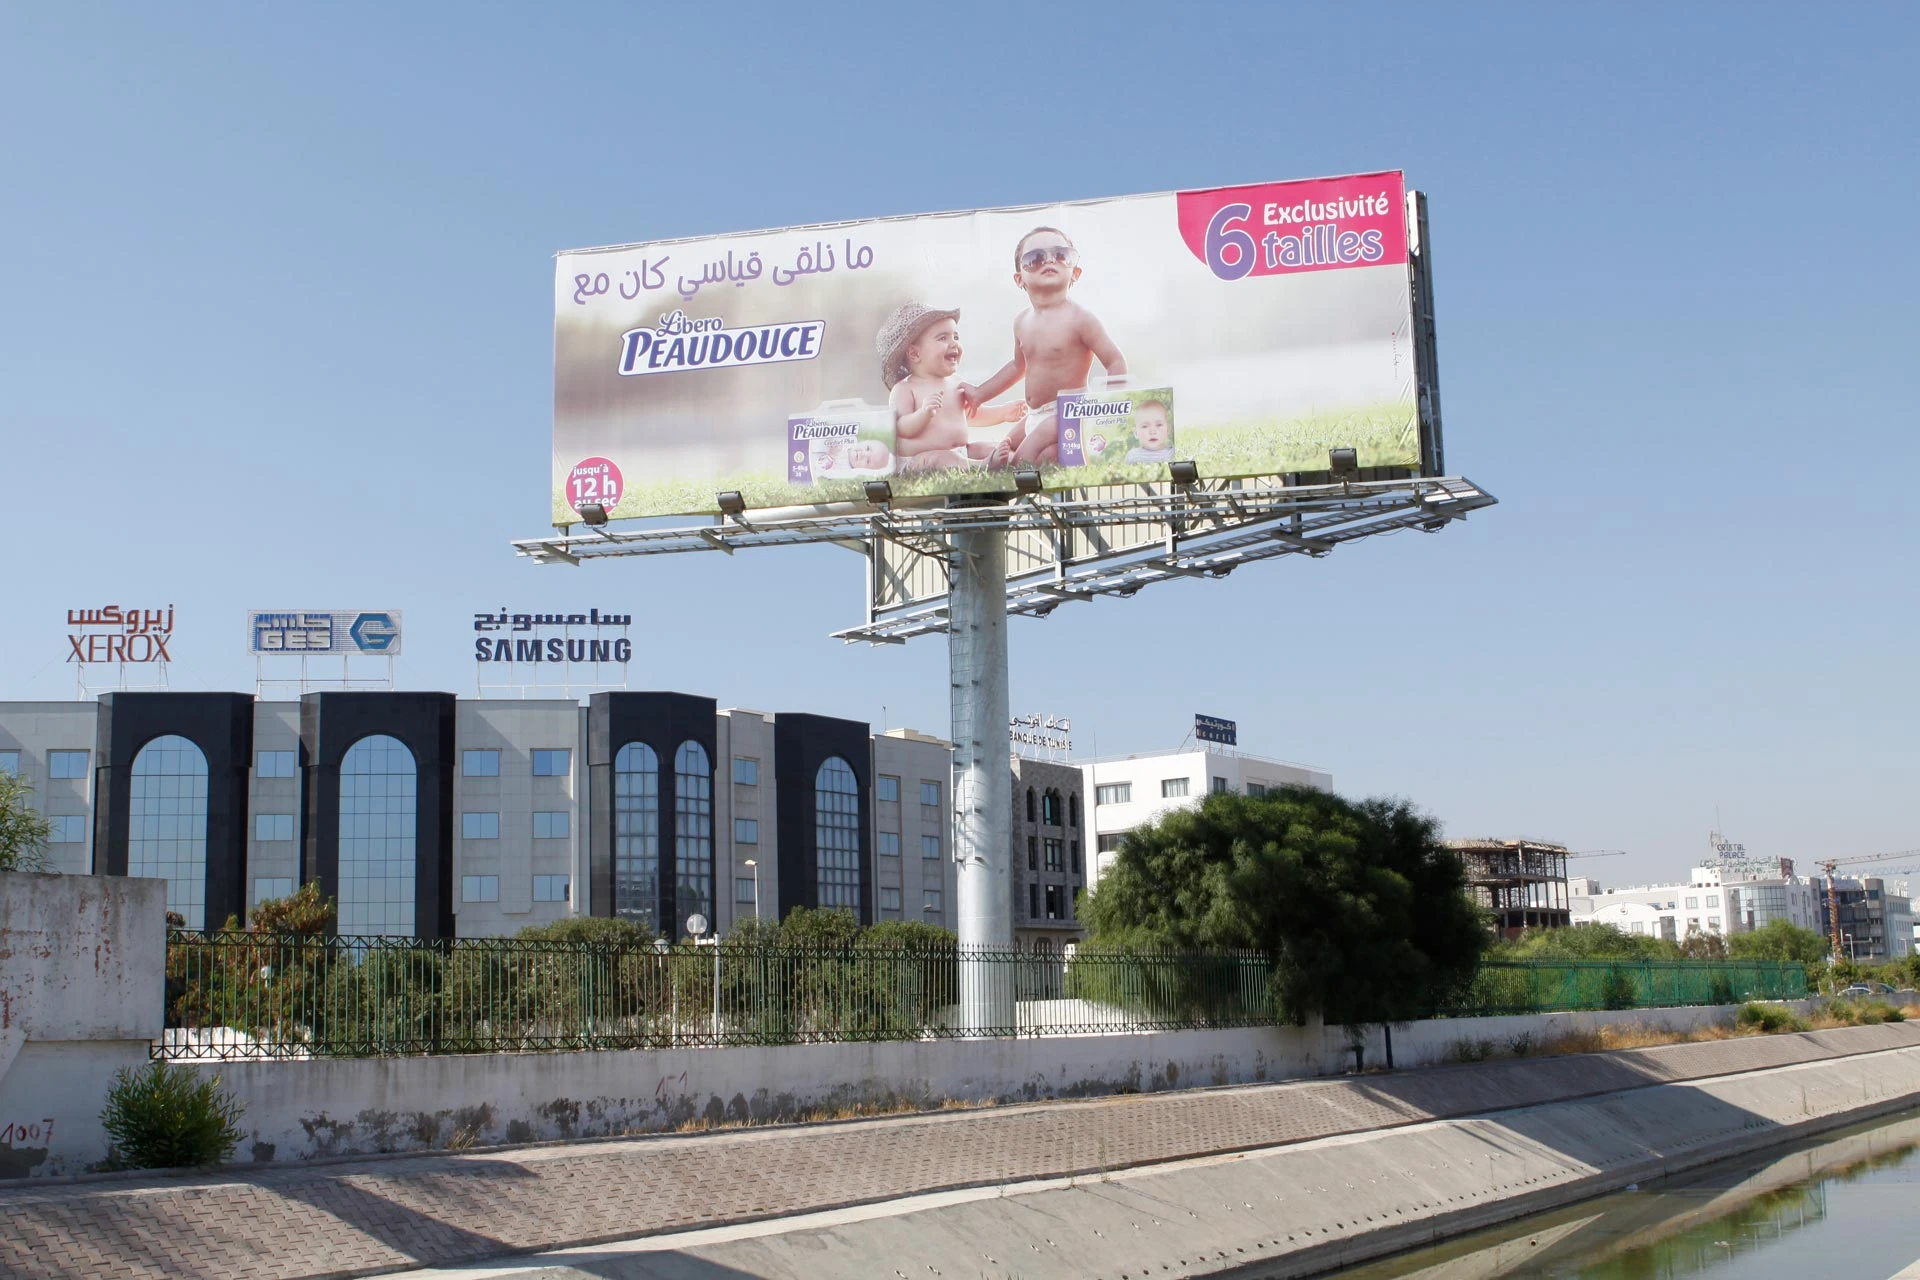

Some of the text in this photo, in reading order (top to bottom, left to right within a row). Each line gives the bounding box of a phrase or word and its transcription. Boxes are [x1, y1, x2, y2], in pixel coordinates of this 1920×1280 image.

[1263, 191, 1389, 225] Exclusivité
[1205, 203, 1384, 281] 6 tailles
[573, 239, 874, 305] ما نلقى قياسي كان مع
[656, 310, 723, 337] Libero
[622, 324, 822, 372] PEAUDOUCE
[1063, 402, 1131, 418] PEAUDOUCE
[794, 424, 858, 440] PEAUDOUCE
[572, 474, 617, 498] 12 h
[67, 603, 174, 634] زيروكس
[474, 606, 631, 631] سامسونج
[66, 634, 172, 663] XEROX
[260, 630, 331, 649] GES
[475, 637, 631, 662] SAMSUNG
[1009, 730, 1037, 744] BANQUE
[1039, 735, 1046, 746] DE
